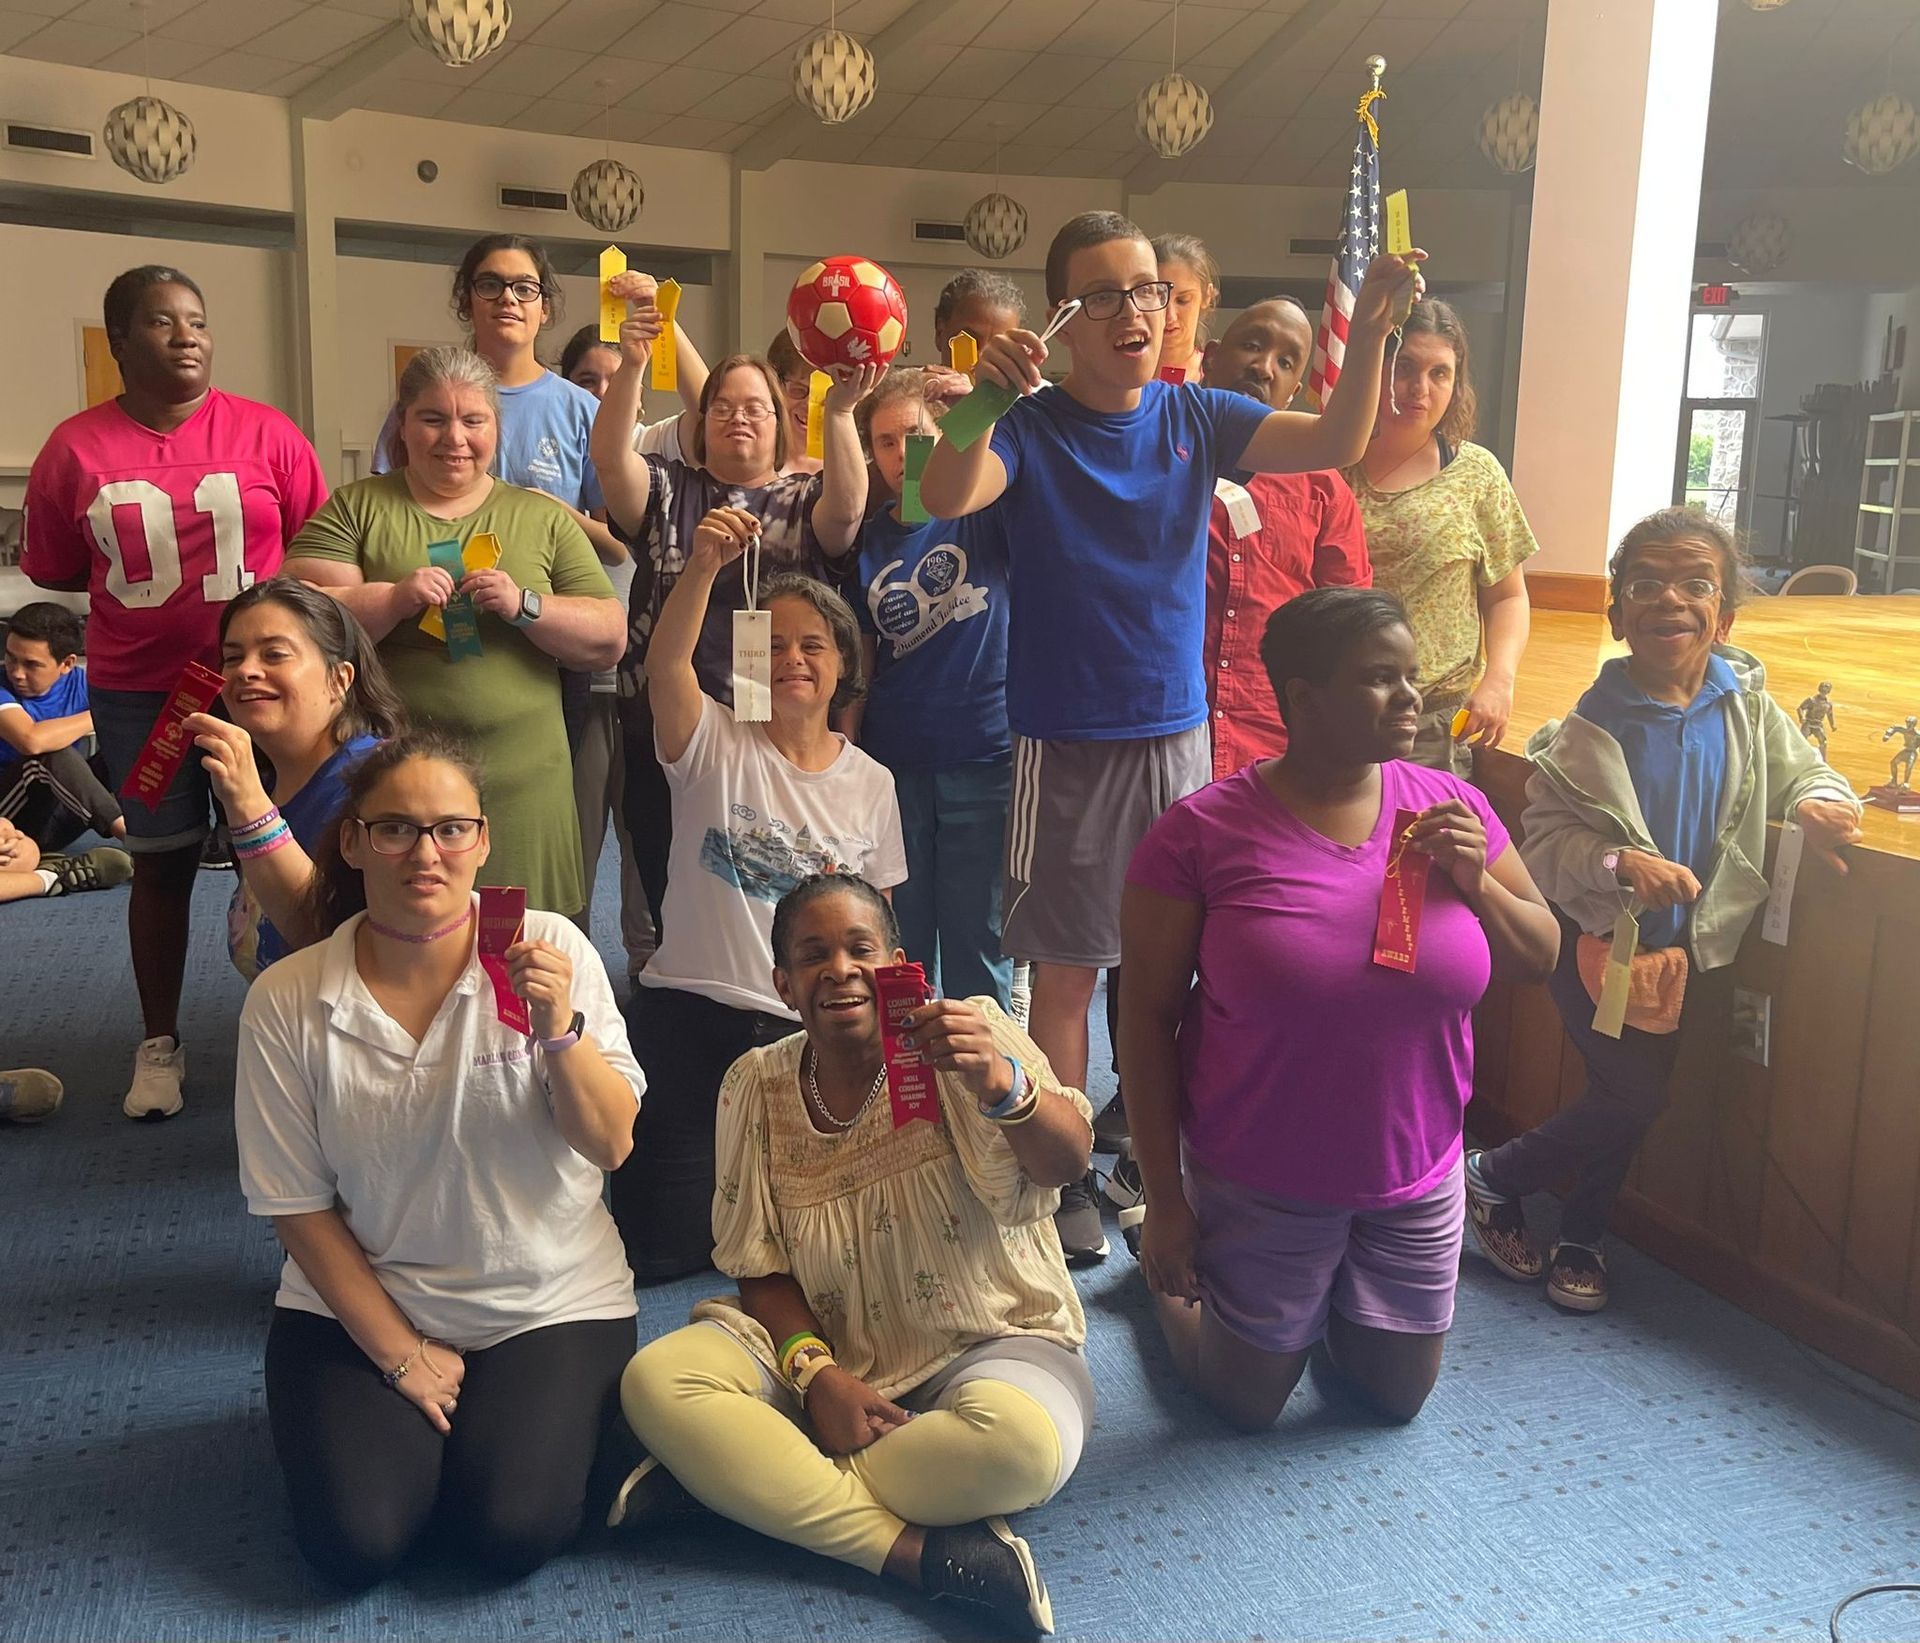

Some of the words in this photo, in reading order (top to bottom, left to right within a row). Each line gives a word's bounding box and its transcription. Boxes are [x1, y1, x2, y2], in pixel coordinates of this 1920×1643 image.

[822, 275, 851, 288] BRASIL
[1702, 287, 1728, 304] EXIT
[926, 552, 948, 568] 1963
[739, 650, 766, 658] THIRD
[1381, 950, 1410, 963] AWARD
[887, 996, 916, 1009] COUNTY
[908, 1102, 921, 1110] JOY
